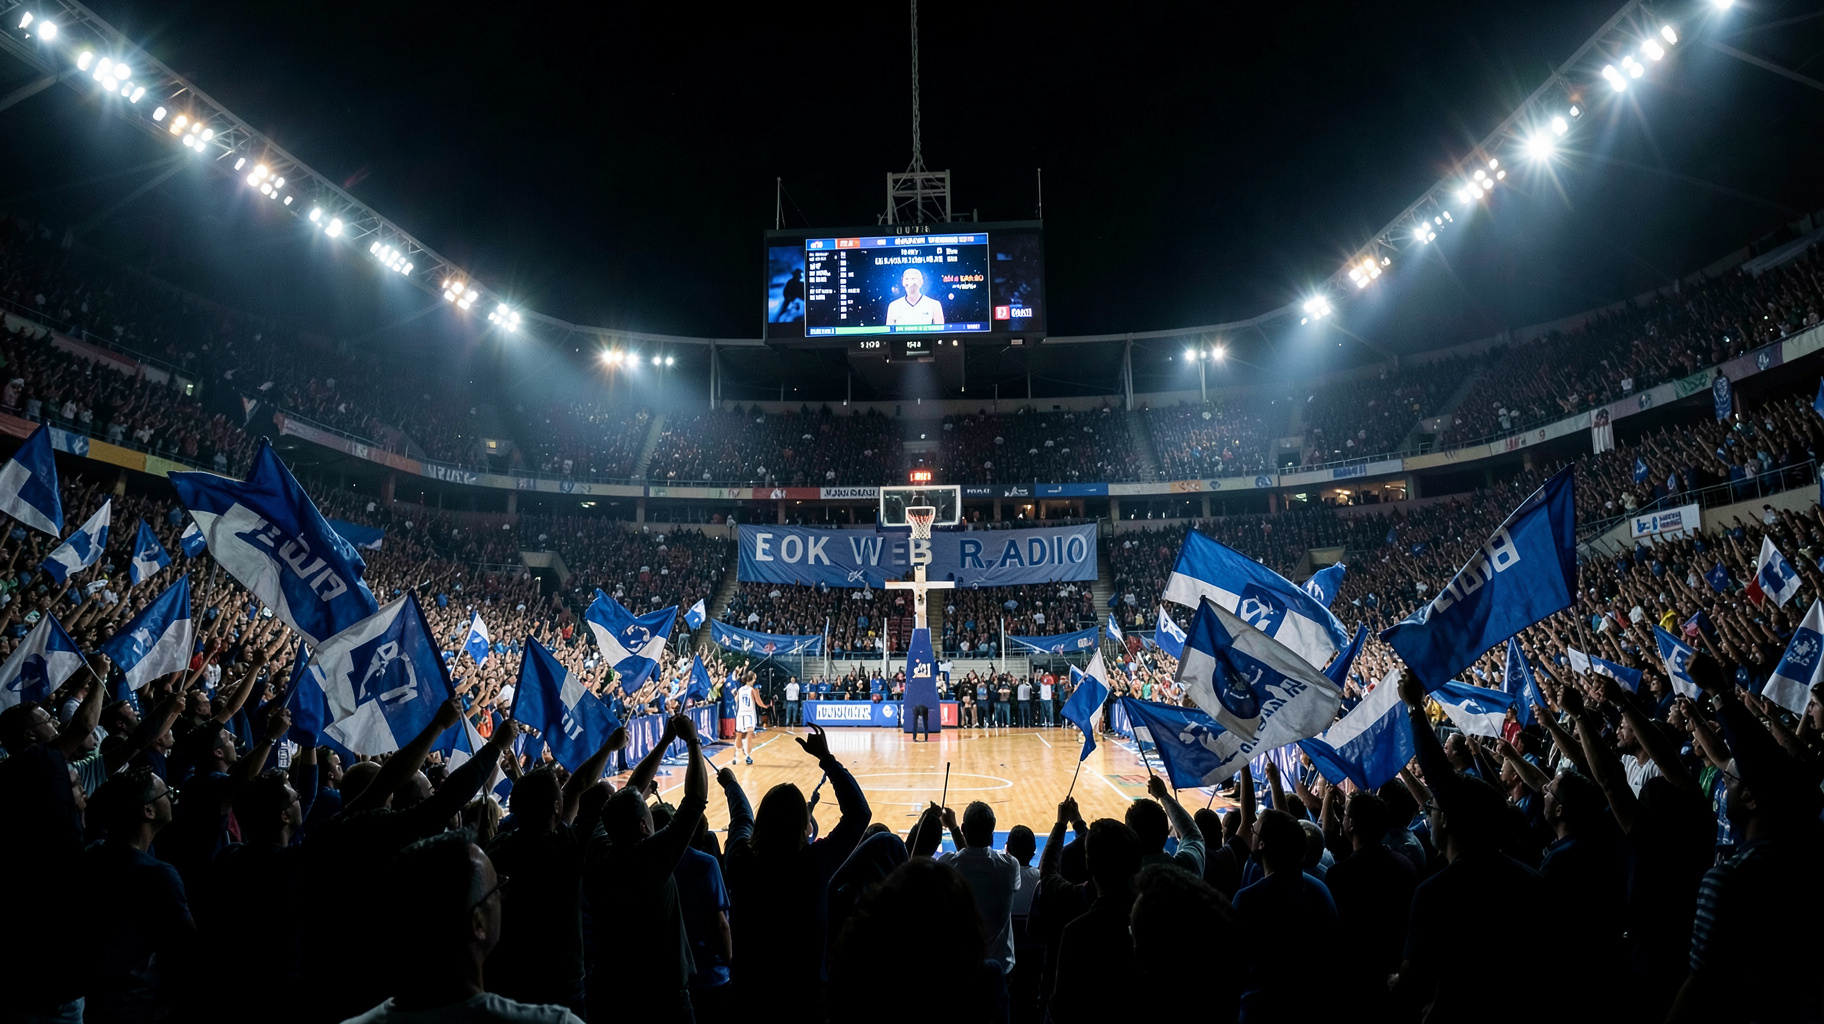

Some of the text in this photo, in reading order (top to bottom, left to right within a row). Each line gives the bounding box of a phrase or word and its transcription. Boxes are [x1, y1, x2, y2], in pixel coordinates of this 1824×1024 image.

[756, 533, 1088, 569] EOK WEB RADIO
